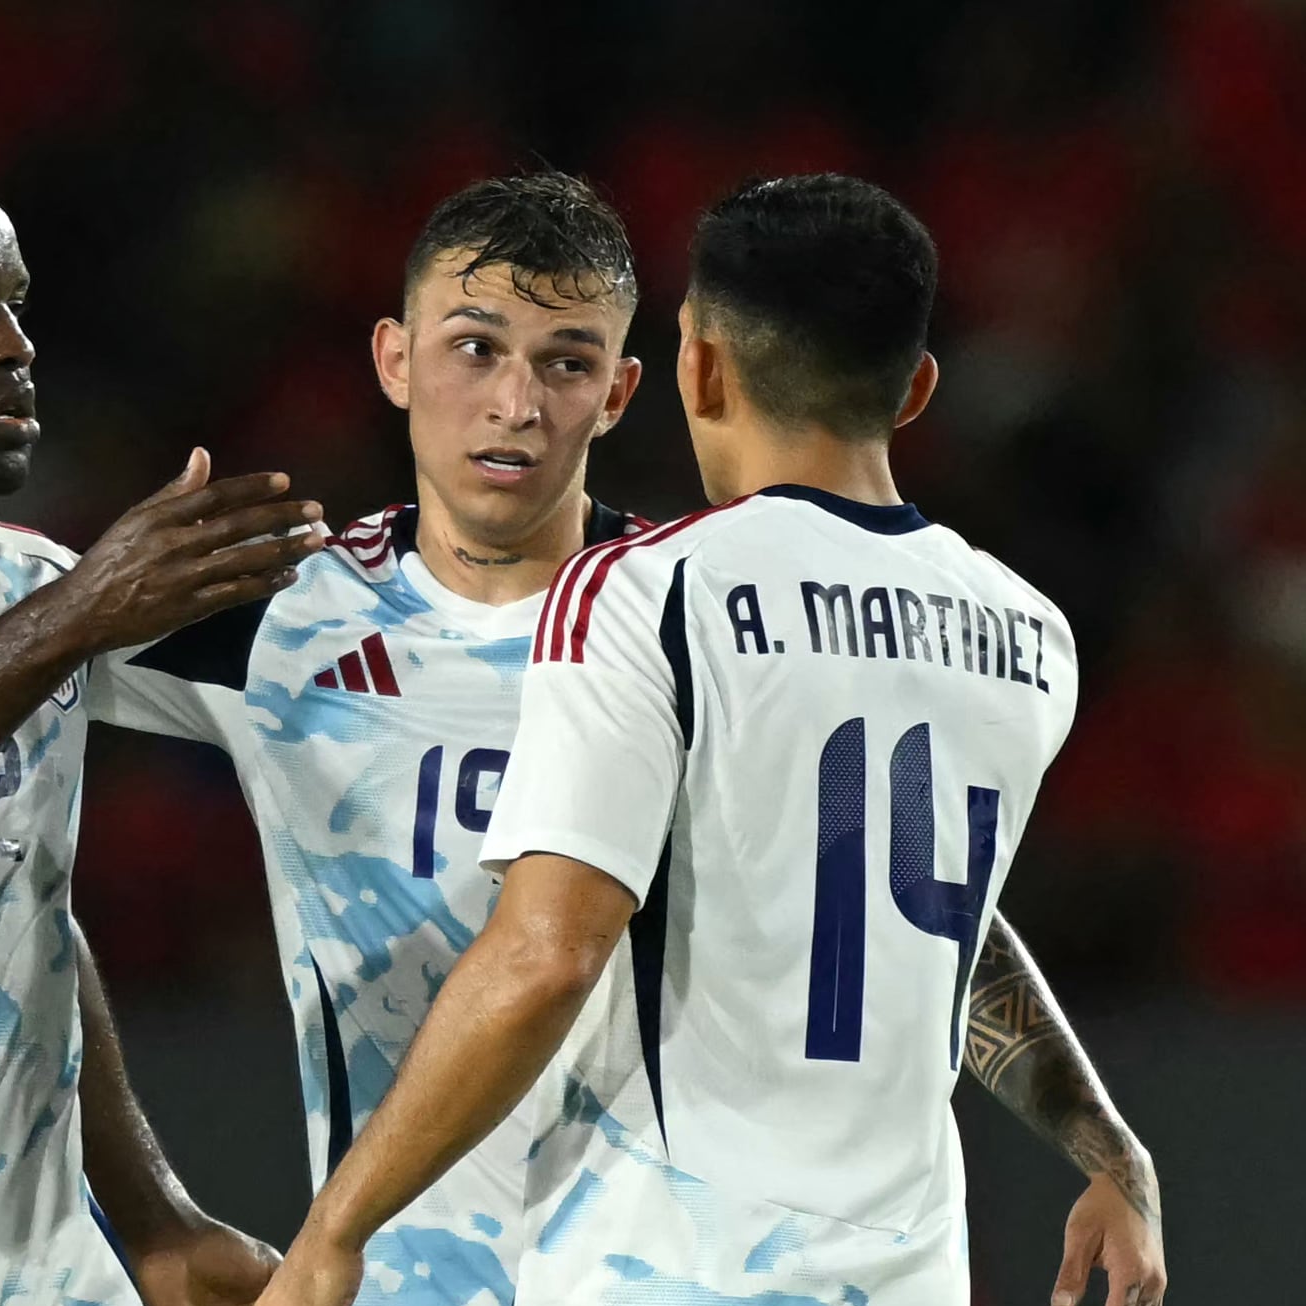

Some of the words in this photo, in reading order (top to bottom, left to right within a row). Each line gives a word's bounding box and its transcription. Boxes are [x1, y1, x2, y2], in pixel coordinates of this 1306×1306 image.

[726, 583, 785, 654] A.
[800, 580, 1050, 694] MARTINEZ
[805, 716, 1000, 1073] 14
